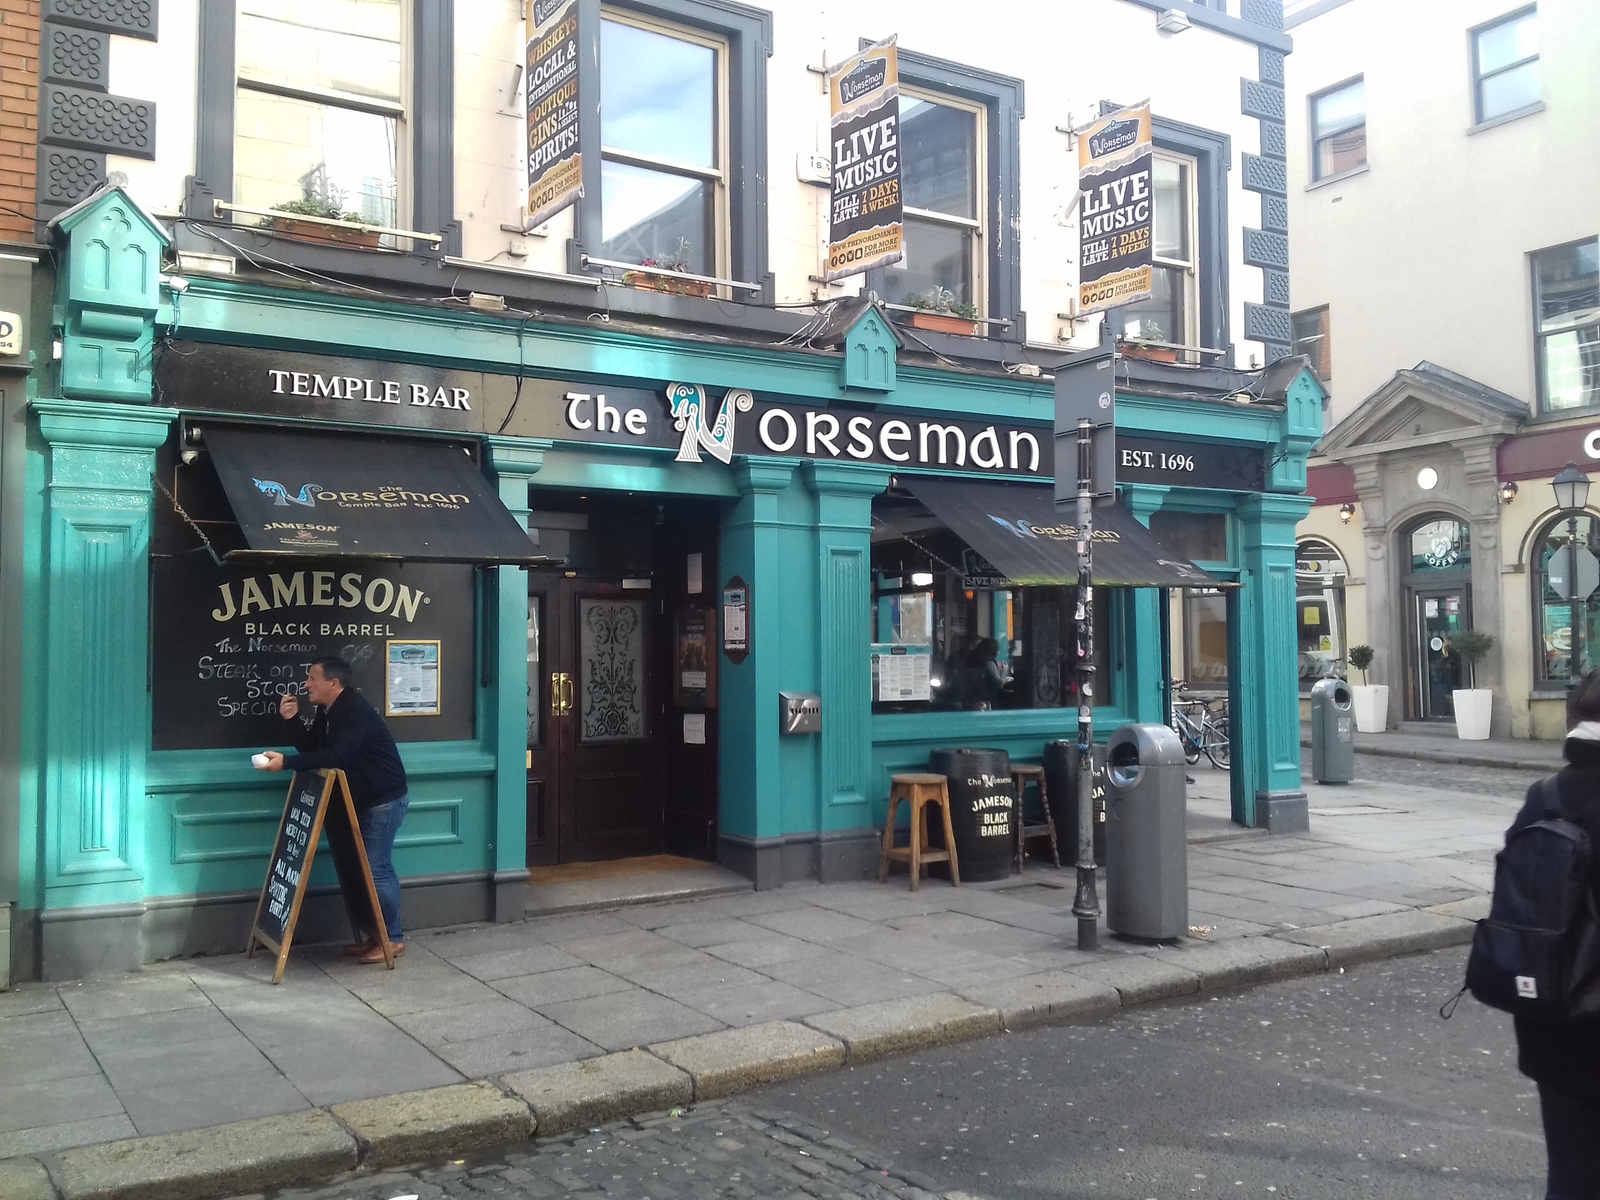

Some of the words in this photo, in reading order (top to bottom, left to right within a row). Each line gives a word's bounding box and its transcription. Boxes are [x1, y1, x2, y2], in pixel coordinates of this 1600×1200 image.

[528, 14, 577, 67] WHISKEYS
[528, 48, 566, 92] LOCAL
[566, 40, 576, 60] &
[528, 60, 577, 106] INTERNATIONAL
[529, 77, 577, 127] BOUTIQUE
[529, 112, 558, 149] GINS
[529, 122, 579, 175] SPIRITS!
[834, 115, 897, 170] LIVE
[834, 149, 898, 195] MUSIC
[833, 205, 859, 225] LATE
[861, 204, 869, 215] A
[869, 192, 900, 212] WEEK!
[834, 193, 860, 213] TILL
[861, 190, 869, 203] 7
[869, 178, 899, 201] DAYS
[1082, 170, 1149, 218] LIVE
[1082, 200, 1149, 240] MUSIC
[879, 236, 898, 249] MORE
[1082, 239, 1109, 256] TILL
[1110, 236, 1118, 249] 7
[1120, 226, 1150, 247] DAYS
[1082, 250, 1109, 267] LATE
[1111, 248, 1119, 259] A
[1119, 239, 1150, 257] WEEK!
[268, 369, 400, 404] TEMPLE
[410, 383, 472, 411] BAR
[1121, 449, 1155, 468] EST.
[1160, 453, 1195, 472] 1696
[1424, 550, 1459, 568] COFFEE
[211, 571, 425, 623] JAMESON
[214, 637, 242, 653] The
[247, 637, 317, 653] Norseman
[245, 623, 311, 636] BLACK
[320, 624, 395, 637] BARREL
[197, 656, 262, 680] STEAK
[981, 824, 1009, 837] BARREL
[983, 811, 1009, 825] BLACK
